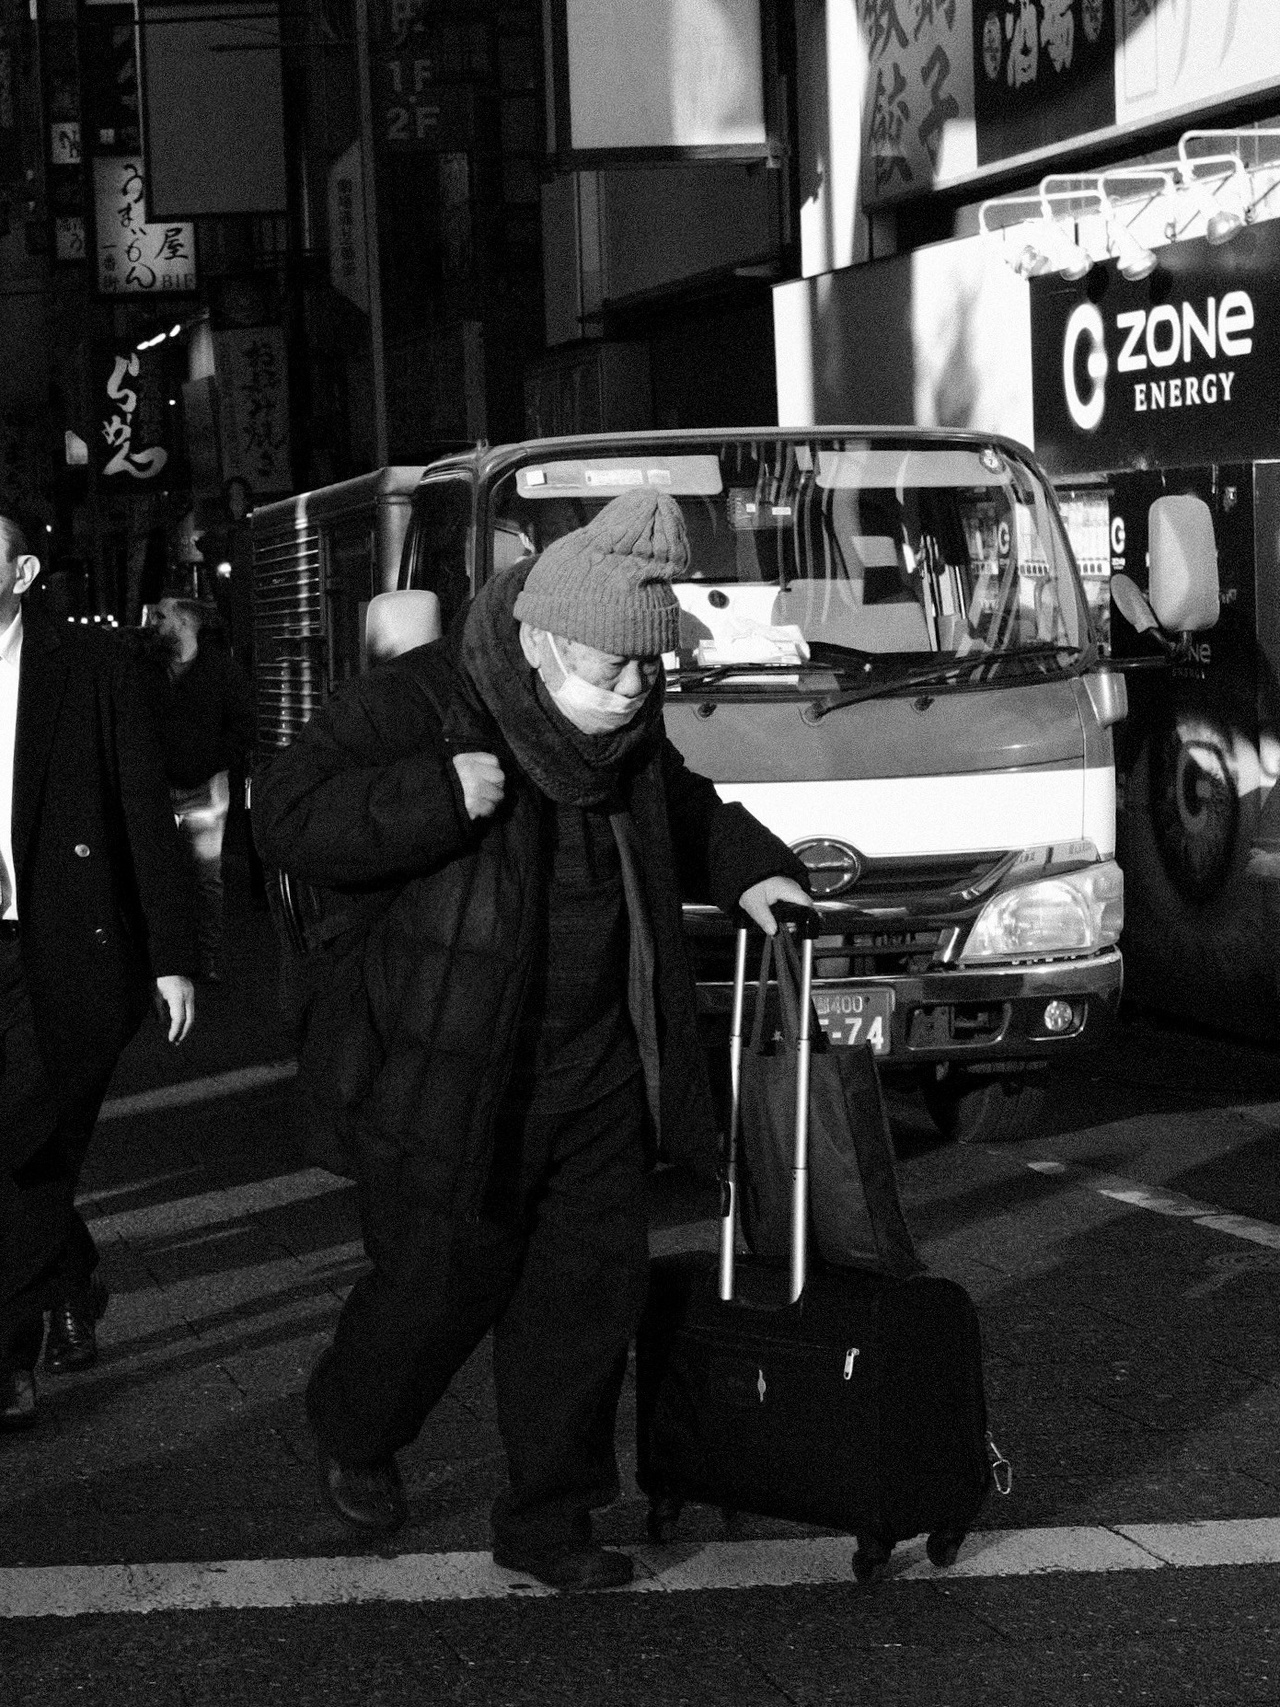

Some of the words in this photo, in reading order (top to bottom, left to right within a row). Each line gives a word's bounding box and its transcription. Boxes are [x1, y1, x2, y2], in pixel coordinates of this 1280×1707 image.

[388, 59, 432, 93] 1F
[386, 105, 441, 140] 2F
[1134, 371, 1235, 412] ENERGY
